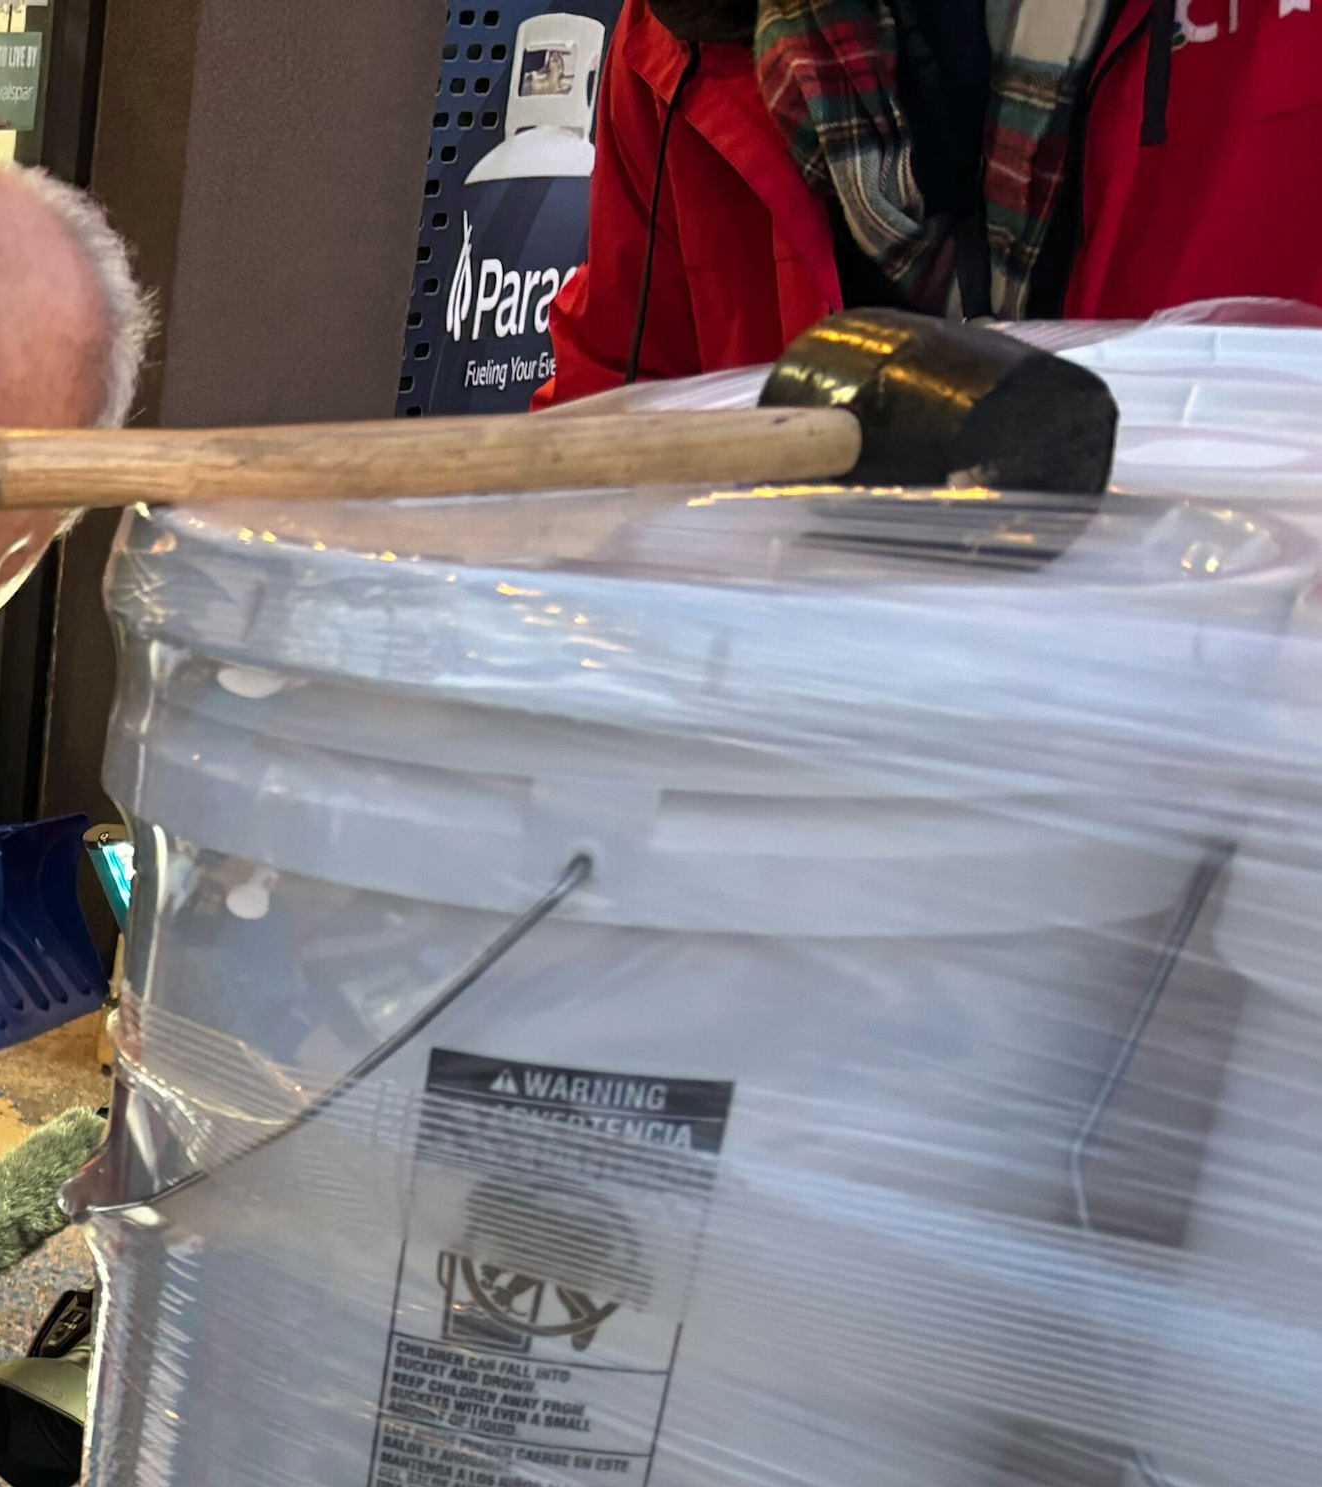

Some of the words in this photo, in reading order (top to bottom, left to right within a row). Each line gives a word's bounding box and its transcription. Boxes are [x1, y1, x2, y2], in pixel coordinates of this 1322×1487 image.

[9, 46, 25, 68] LIVE
[26, 46, 38, 69] BY
[464, 359, 508, 391] Fueling
[511, 355, 537, 383] Your
[523, 1068, 669, 1112] WARNING
[498, 1360, 532, 1378] FALL
[452, 1398, 489, 1417] WITH
[491, 1405, 528, 1424] EVEN
[529, 1411, 541, 1425] A
